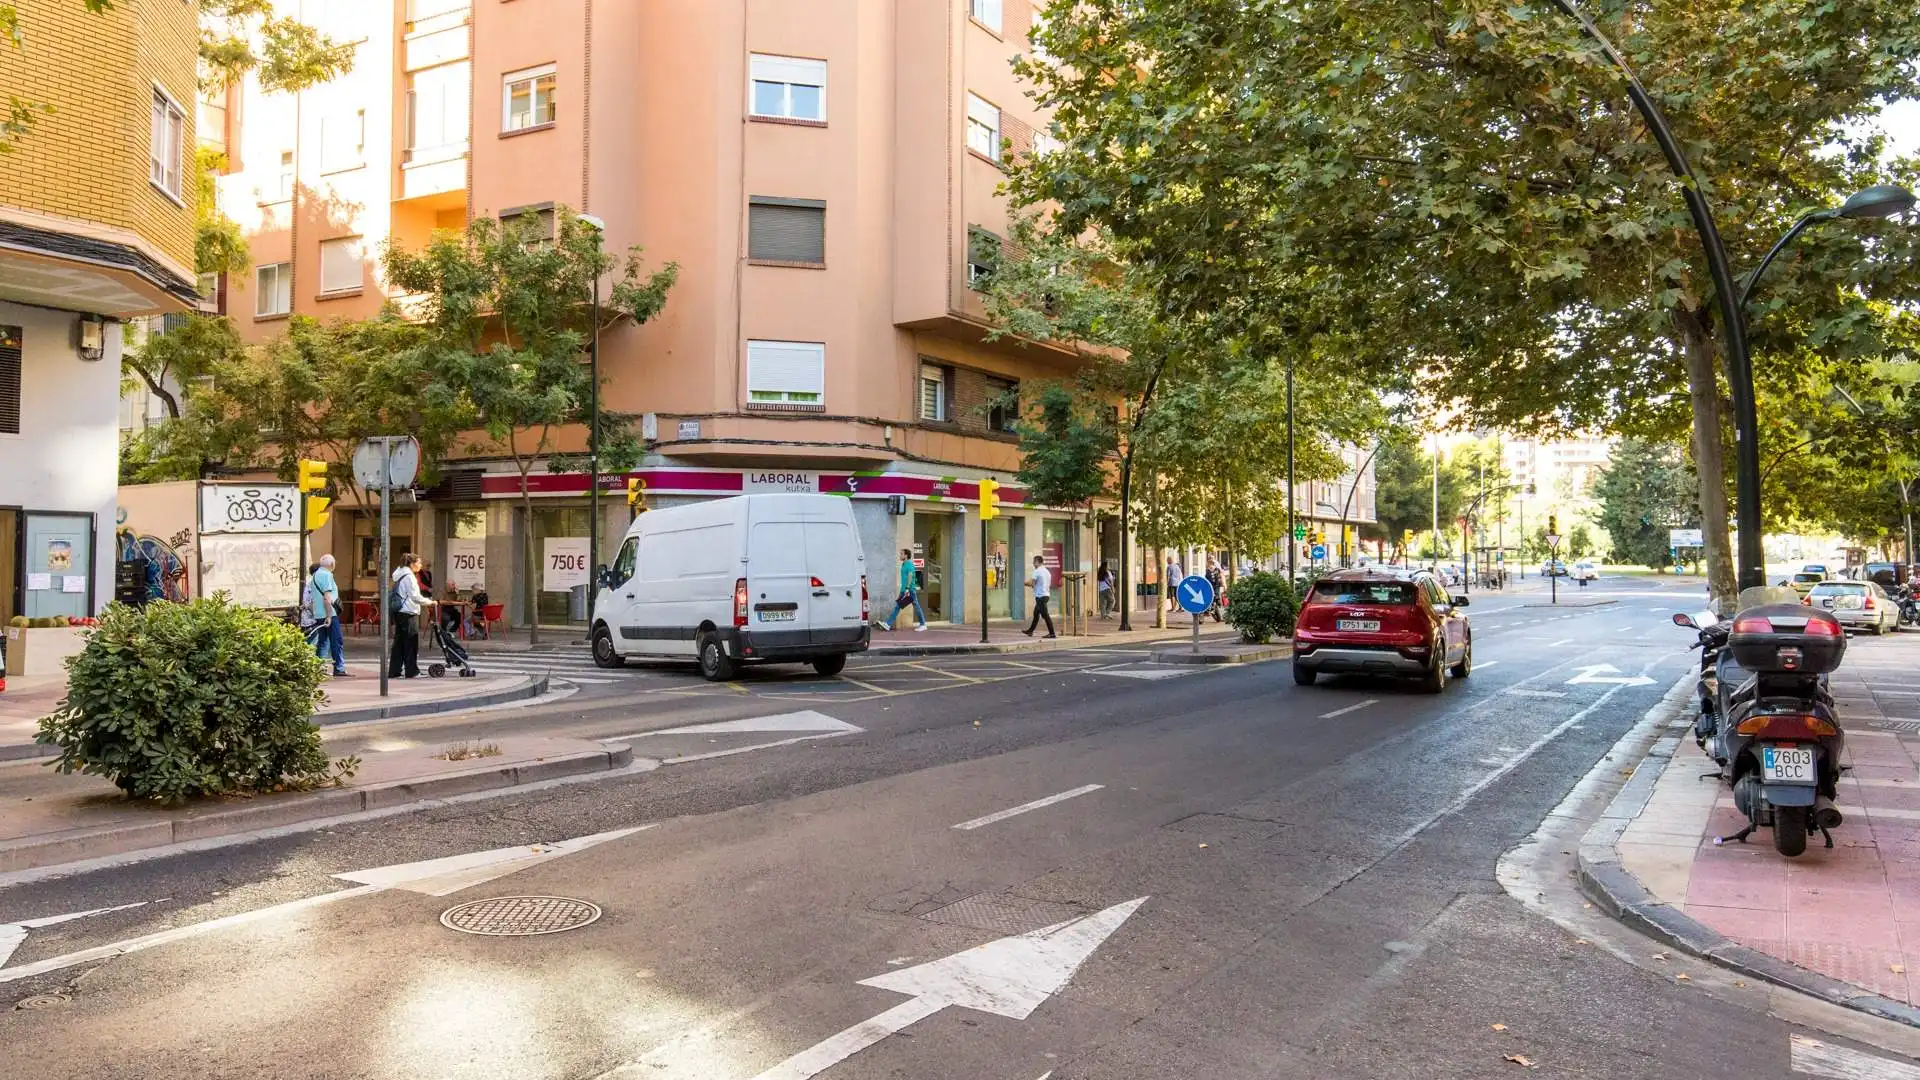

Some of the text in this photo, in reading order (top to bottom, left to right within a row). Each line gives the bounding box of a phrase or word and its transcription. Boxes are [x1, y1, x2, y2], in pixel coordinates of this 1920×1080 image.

[598, 475, 622, 483] ABORAL
[751, 473, 811, 484] LABORAL
[785, 485, 811, 493] kutxa
[453, 555, 485, 569] 750 €
[551, 555, 585, 570] 750 €
[1342, 621, 1360, 629] 8751
[1774, 751, 1810, 764] 7603
[1775, 765, 1804, 778] BCC
